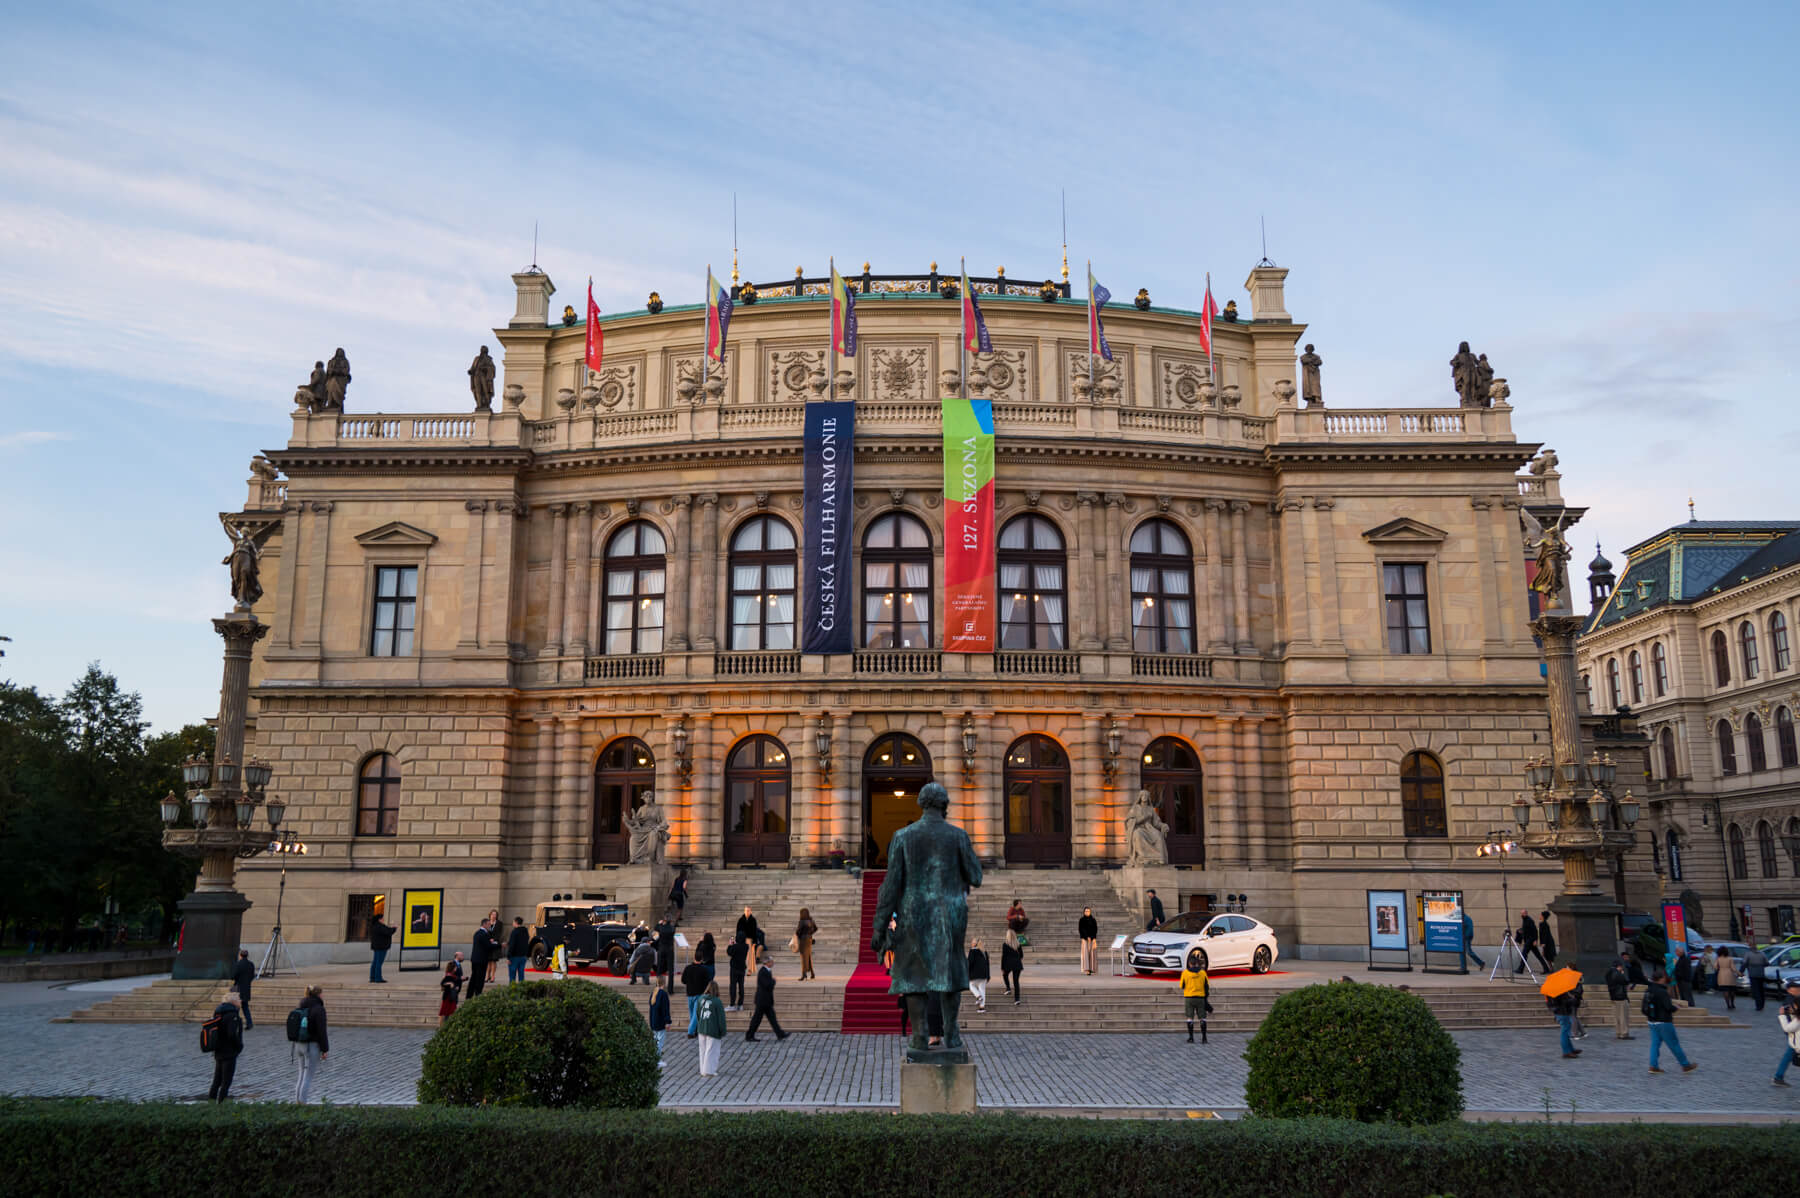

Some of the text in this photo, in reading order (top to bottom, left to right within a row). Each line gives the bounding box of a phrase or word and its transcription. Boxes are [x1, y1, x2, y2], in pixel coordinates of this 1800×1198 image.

[817, 417, 837, 631] ČESKÁ FILHARMONIE
[962, 436, 978, 551] 127. SEZONA
